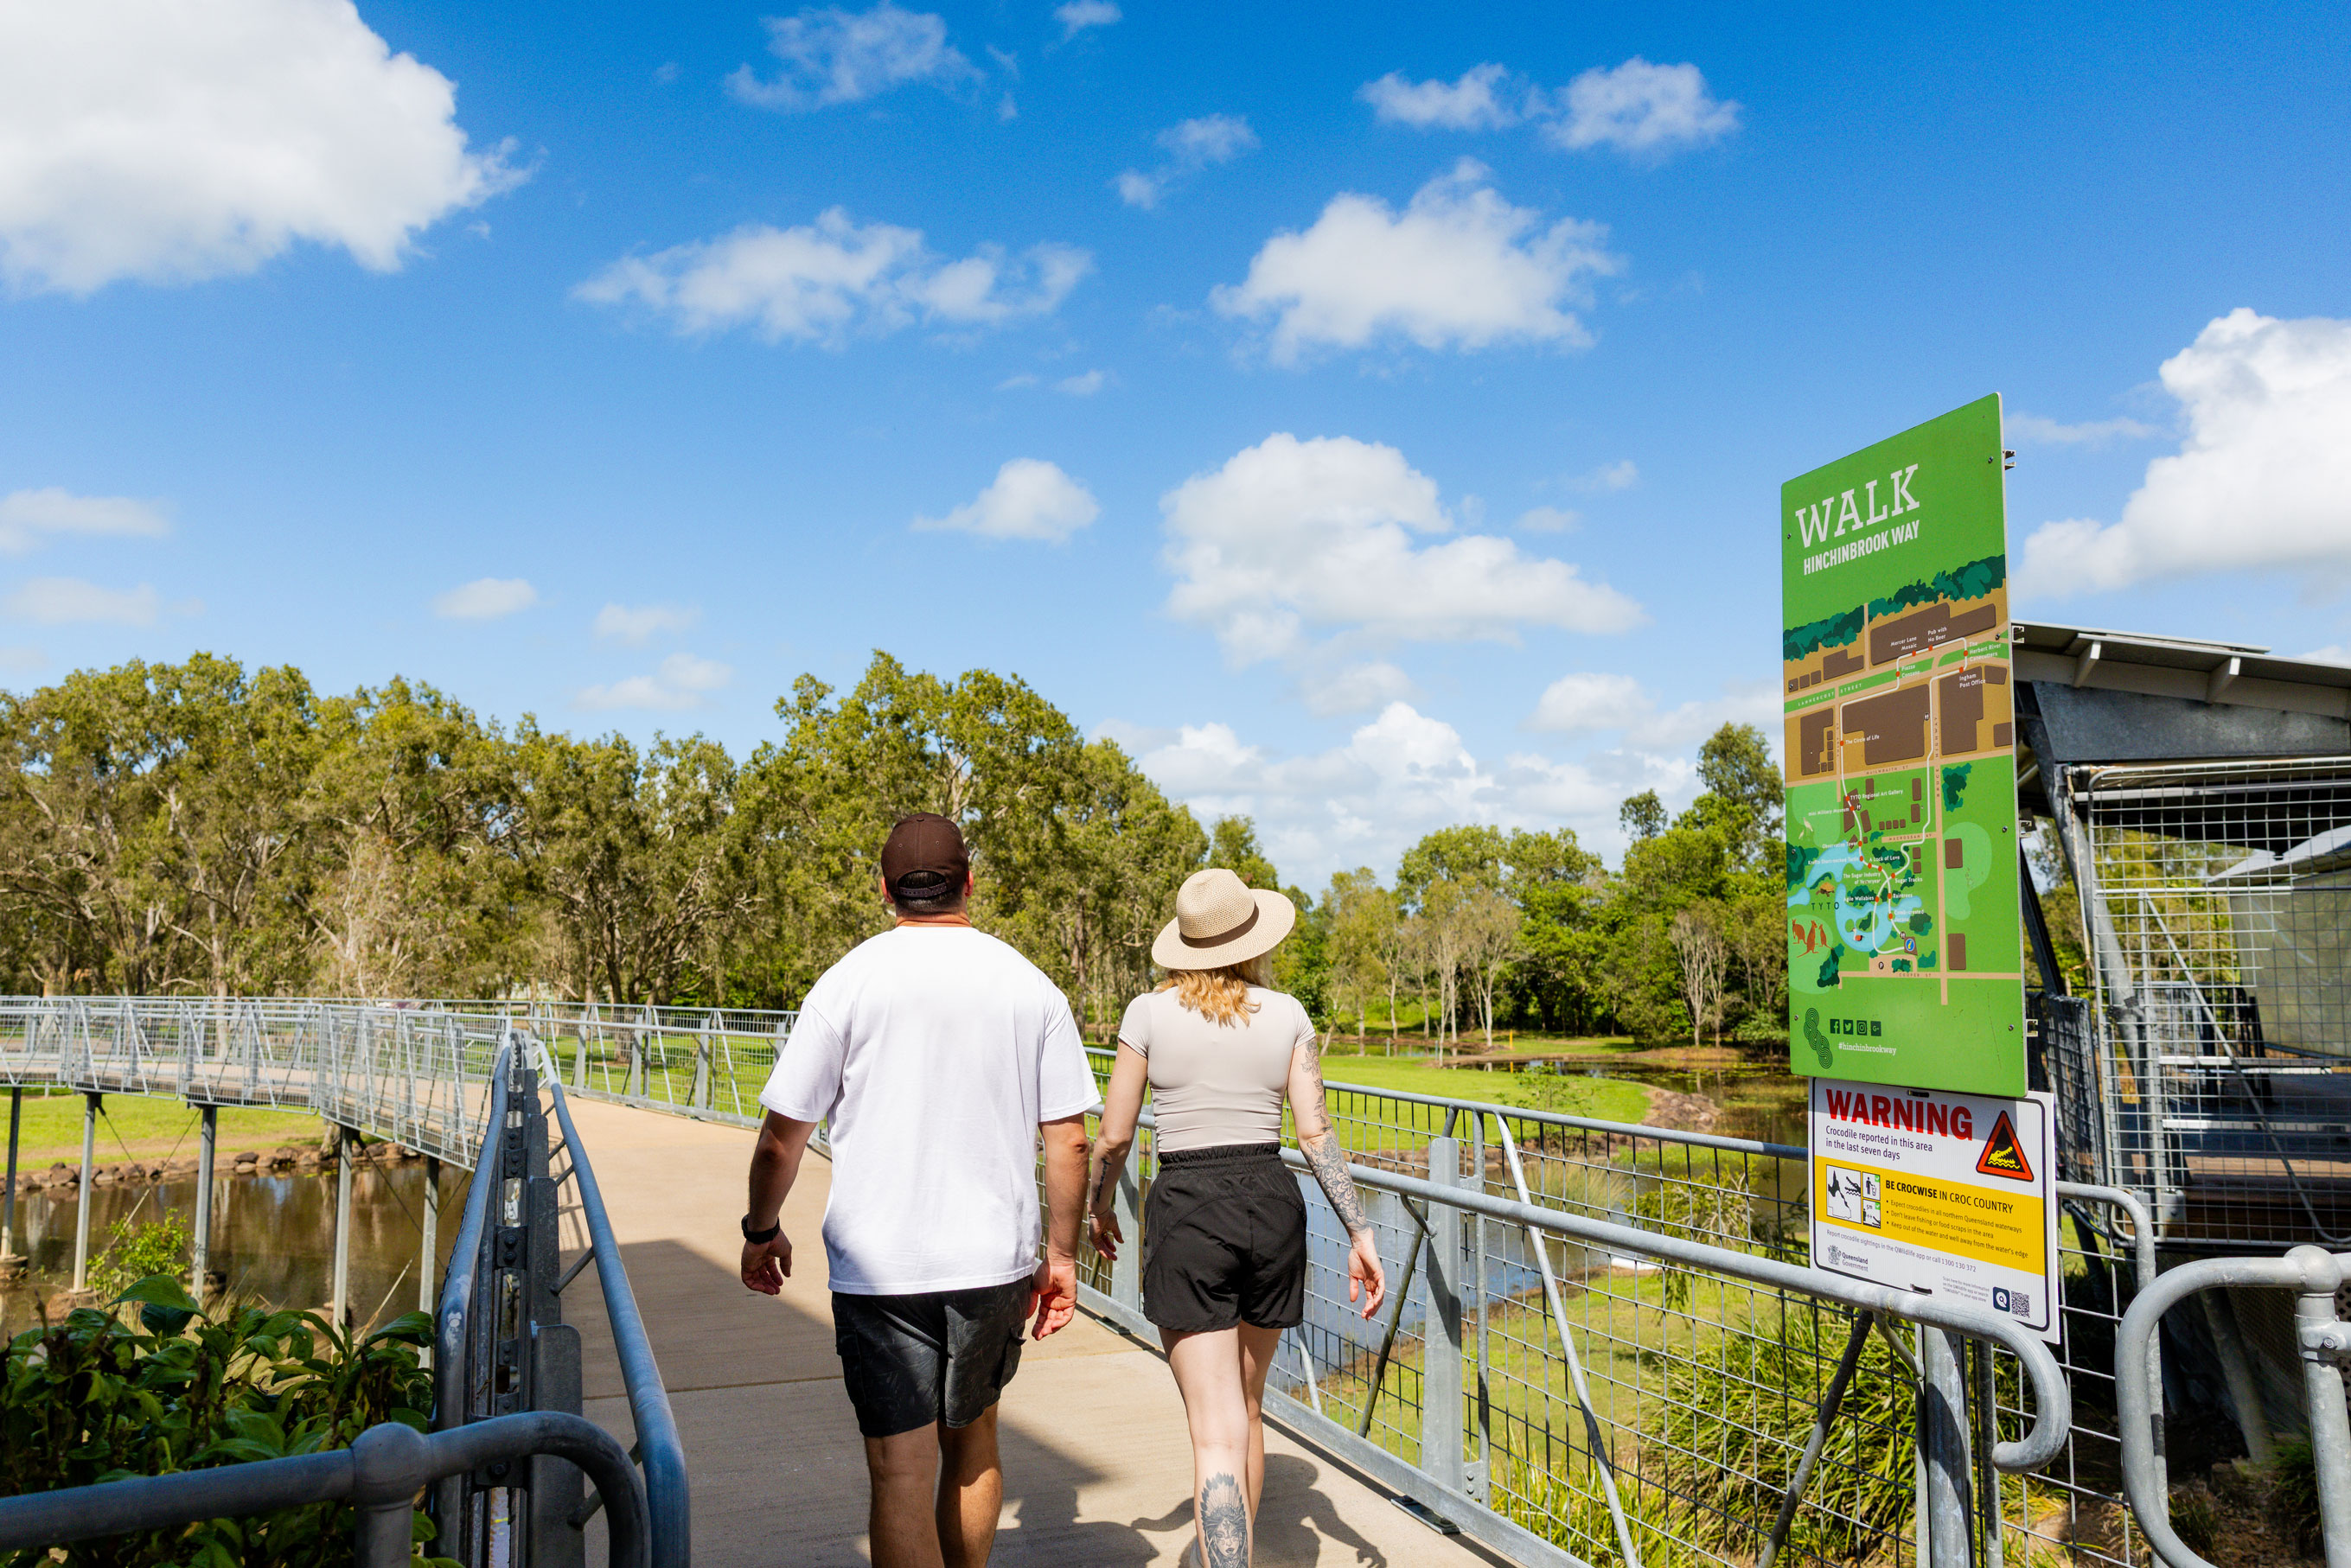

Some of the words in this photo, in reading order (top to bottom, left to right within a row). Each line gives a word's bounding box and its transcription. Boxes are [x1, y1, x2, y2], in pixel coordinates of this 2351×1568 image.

[1795, 463, 1920, 548] WALK
[1804, 530, 1889, 576] HINCHINBROOK
[1891, 519, 1920, 545] WAY
[1840, 683, 1862, 694] STREET
[1959, 673, 1977, 682] Ingham
[1811, 902, 1840, 911] TYTO
[1838, 1042, 1897, 1056] #hinchinbrookway
[1826, 1088, 1972, 1141] WARNING
[1825, 1138, 1832, 1147] in
[1834, 1139, 1844, 1150] the
[1846, 1142, 1859, 1152] last
[1861, 1146, 1881, 1157] seven
[1883, 1148, 1901, 1161] days
[1826, 1125, 1857, 1139] Crocodile
[1858, 1131, 1889, 1145] reported
[1890, 1136, 1898, 1145] in
[1900, 1138, 1913, 1149] this
[1915, 1143, 1933, 1152] area
[1886, 1179, 1895, 1190] BE
[1896, 1182, 1938, 1199] CROCWISE
[1939, 1190, 1947, 1201] IN
[1949, 1192, 1971, 1206] CROC
[1973, 1197, 2013, 1214] COUNTRY
[1906, 1203, 1929, 1214] crocodiles
[1942, 1211, 1963, 1221] northern
[1964, 1215, 1994, 1227] Queensland
[1995, 1223, 2022, 1234] waterways
[1916, 1215, 1933, 1226] fishing
[1939, 1221, 1950, 1229] food
[1951, 1224, 1966, 1233] scraps
[1826, 1229, 1840, 1238] Report
[1840, 1233, 1860, 1243] crocodile
[1860, 1238, 1881, 1249] sightings
[1894, 1246, 1915, 1258] QWildlife
[1915, 1252, 1926, 1260] app
[1955, 1261, 1965, 1270] 130
[1966, 1264, 1977, 1272] 372
[1891, 1221, 1902, 1229] Keep
[1973, 1240, 1985, 1248] from
[1995, 1245, 2014, 1255] water's
[2015, 1250, 2028, 1259] edge
[1842, 1252, 1869, 1265] Queensland
[1842, 1259, 1869, 1272] Government
